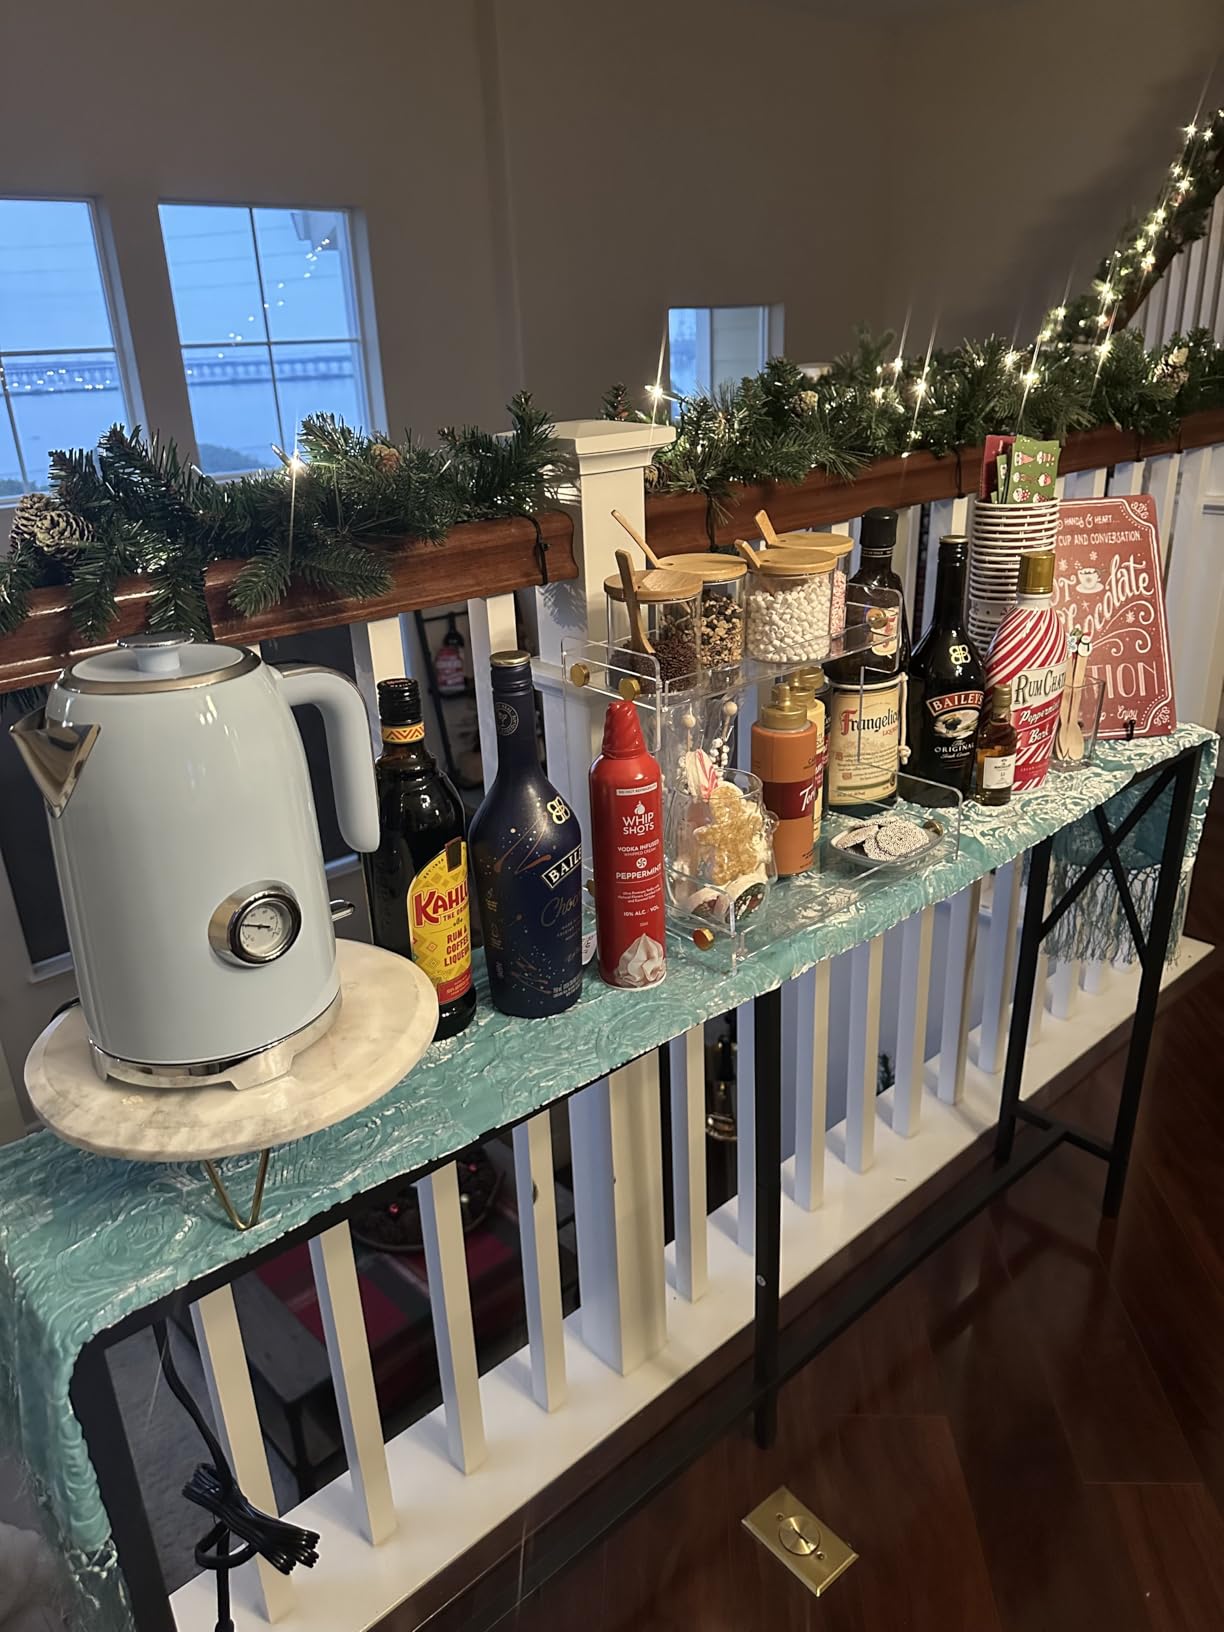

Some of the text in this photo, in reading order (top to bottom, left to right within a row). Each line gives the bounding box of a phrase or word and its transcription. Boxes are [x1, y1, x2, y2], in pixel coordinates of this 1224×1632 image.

[1058, 534, 1071, 546] CUP
[1074, 534, 1088, 545] AND
[932, 693, 984, 711] BAILEYS
[1117, 705, 1138, 722] Enjoy
[622, 812, 654, 826] WHIP
[623, 822, 655, 836] SHOTS
[443, 912, 455, 921] THE
[447, 928, 462, 944] RUM
